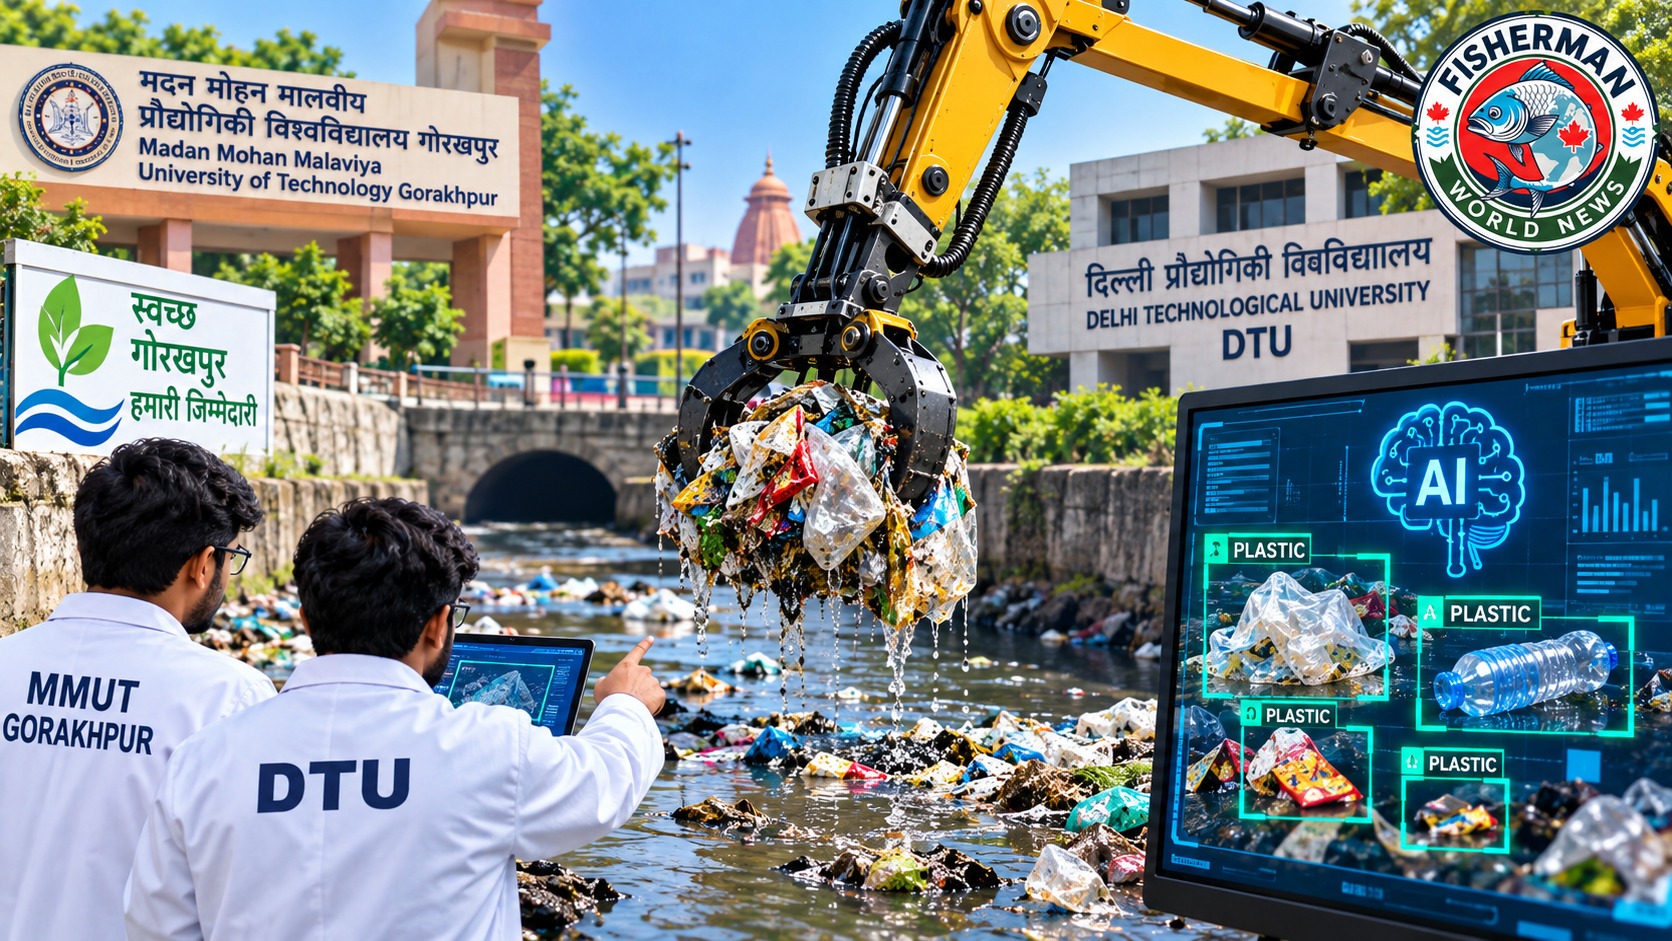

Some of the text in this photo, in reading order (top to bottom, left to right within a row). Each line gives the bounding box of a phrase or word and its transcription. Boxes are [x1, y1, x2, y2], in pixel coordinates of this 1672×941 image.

[139, 71, 367, 113] मदन मोहन मालवीय
[138, 98, 499, 164] प्रौद्योगिकी विश्वविद्यालय गोरखपुर
[140, 137, 381, 177] Madan Mohan Malaviya
[139, 162, 497, 208] University of Technology Gorakhpur
[1085, 257, 1154, 298] दिल्ली
[1164, 245, 1272, 290] प्रौद्योगिकी
[131, 292, 197, 330] स्वच्छ
[1087, 280, 1430, 330] DELHI TECHNOLOGICAL UNIVERSITY
[131, 329, 227, 389] गोरखपुर
[1223, 325, 1291, 360] DTU
[130, 386, 257, 426] हमारी जिम्मेदारी
[1416, 458, 1465, 505] AI
[1234, 541, 1305, 559] PLASTIC
[1450, 604, 1531, 623] PLASTIC
[27, 672, 140, 713] MMUT
[3, 713, 153, 755] GORAKHPUR
[1266, 708, 1330, 724] PLASTIC
[1429, 755, 1497, 773] PLASTIC
[257, 758, 410, 813] DTU
